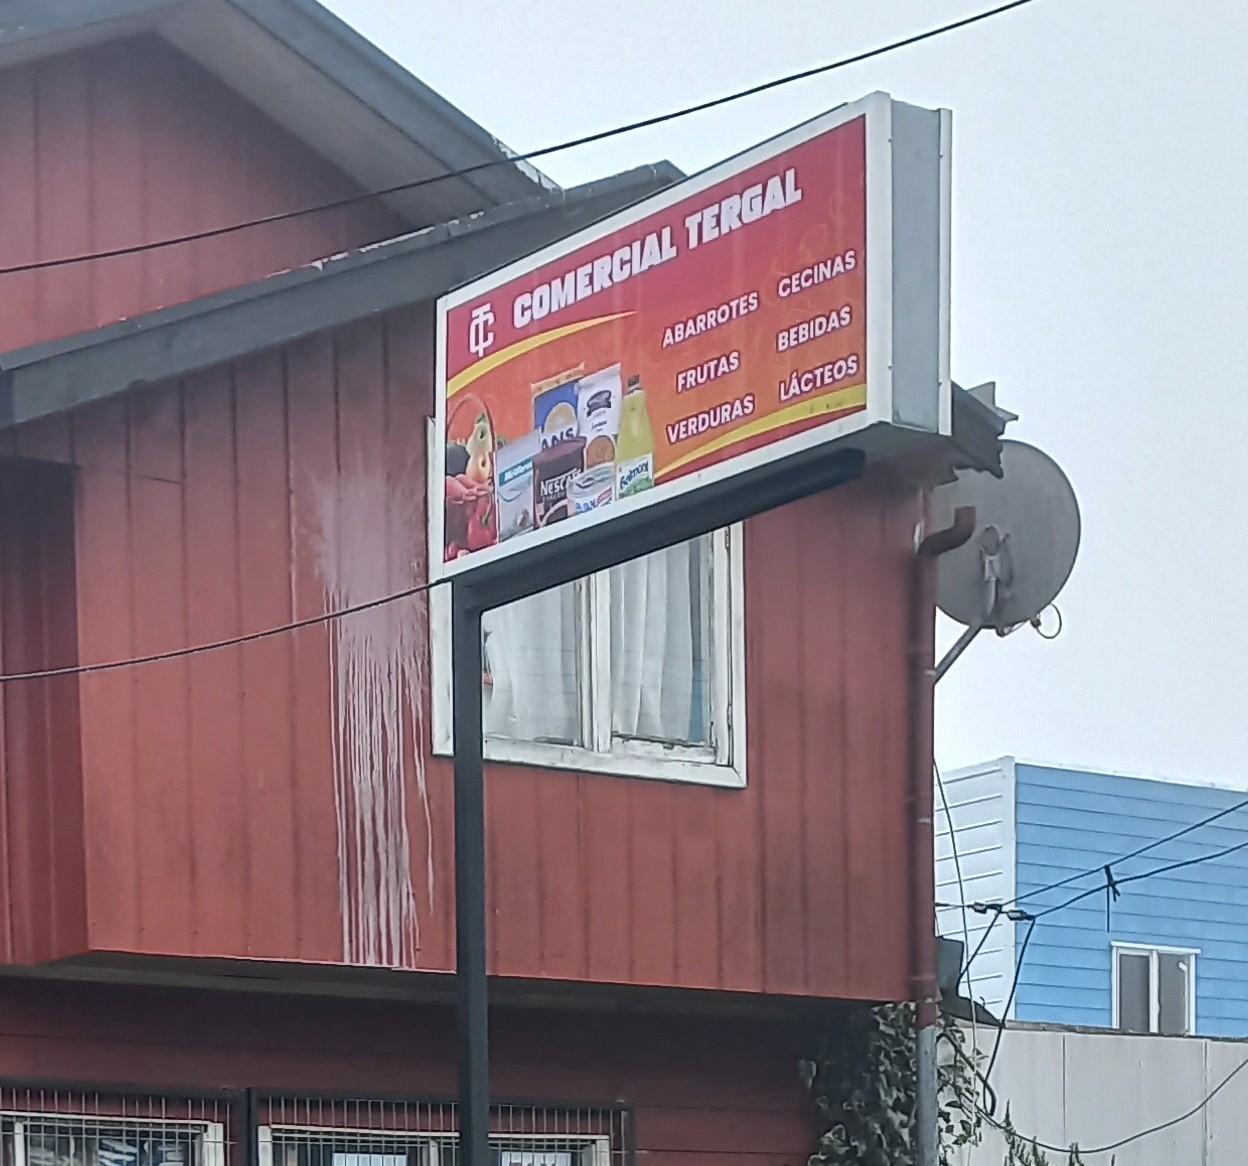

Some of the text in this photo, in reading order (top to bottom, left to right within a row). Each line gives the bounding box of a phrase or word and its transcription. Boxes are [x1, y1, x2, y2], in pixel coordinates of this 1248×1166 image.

[513, 167, 802, 329] COMERCIAL TERGAL
[777, 250, 856, 298] CECINAS
[662, 292, 759, 349] ABARROTES
[776, 306, 851, 352] BEBIDAS
[676, 351, 740, 393] FRUTAS
[778, 354, 859, 402] LÁCTEOS
[666, 395, 755, 444] VERDURAS
